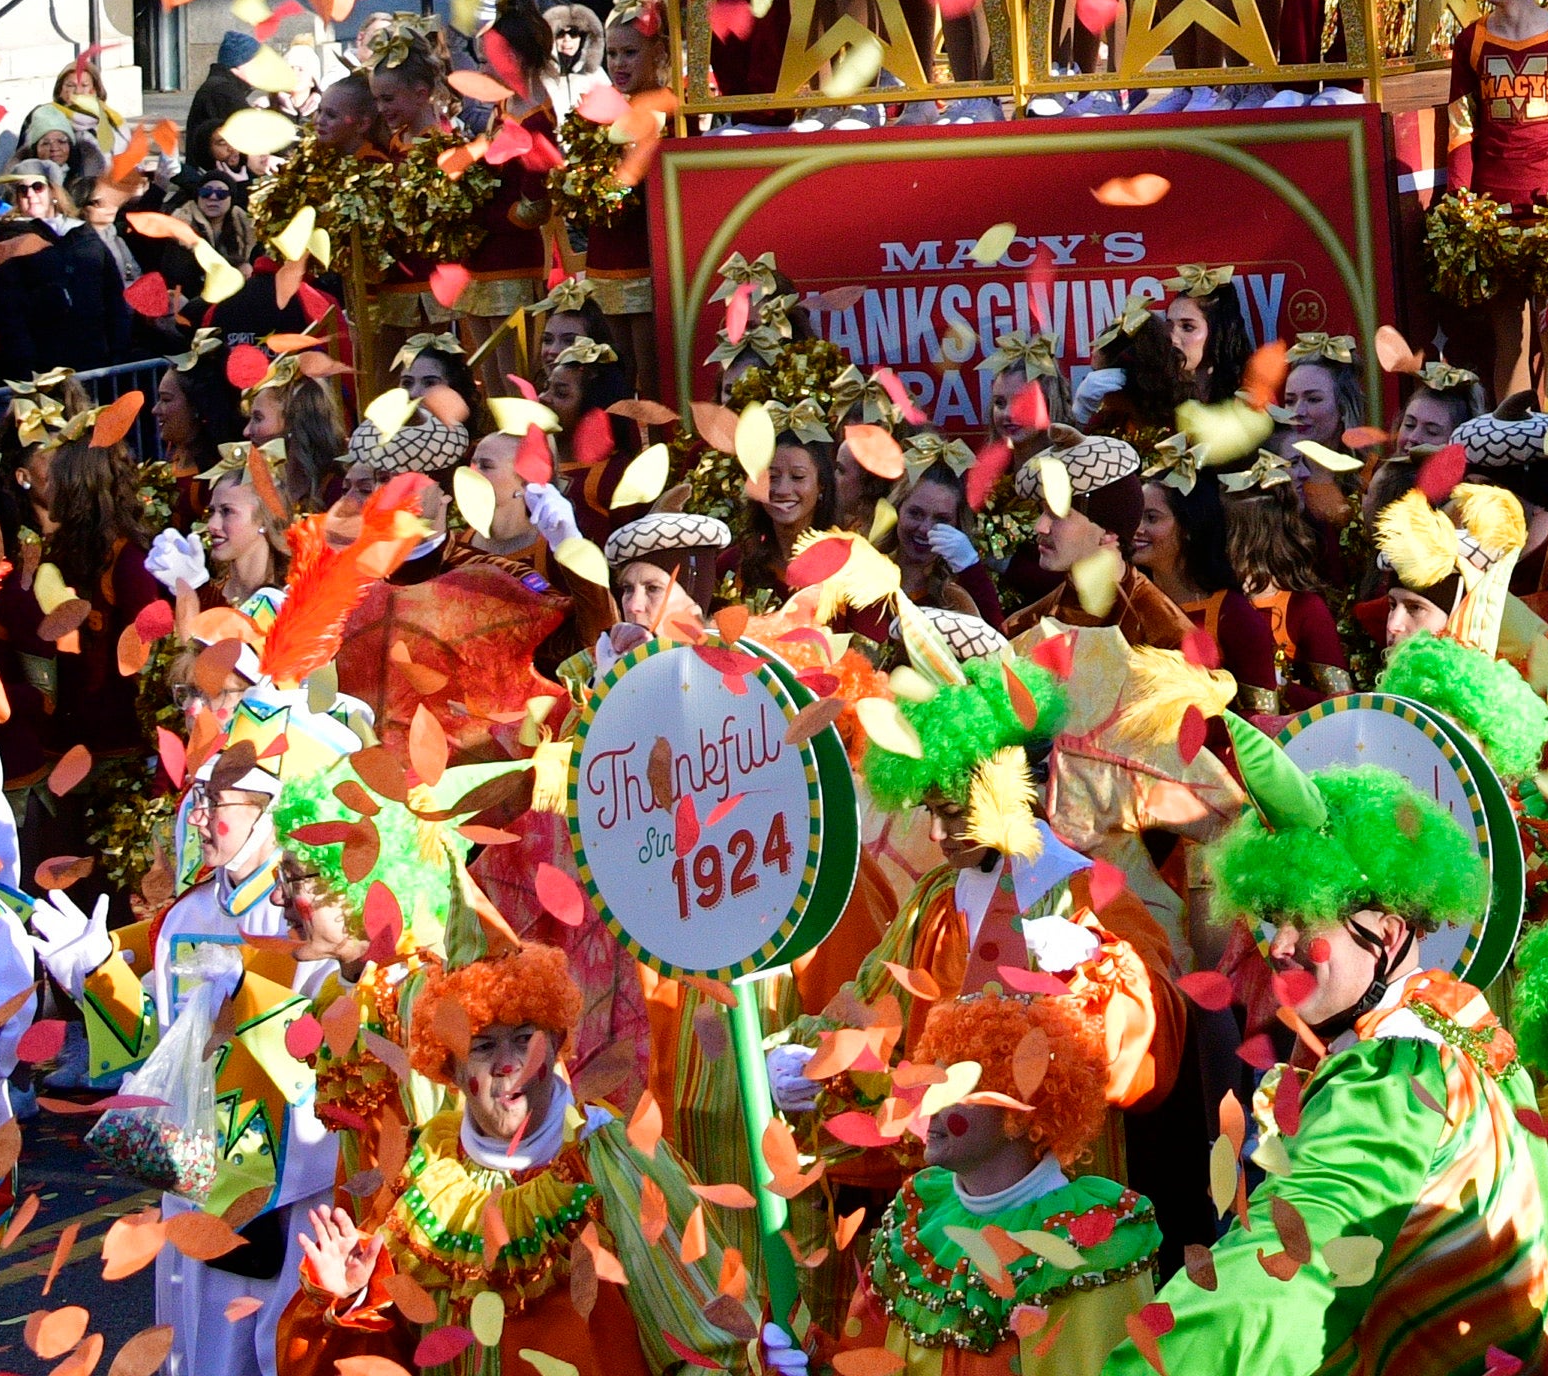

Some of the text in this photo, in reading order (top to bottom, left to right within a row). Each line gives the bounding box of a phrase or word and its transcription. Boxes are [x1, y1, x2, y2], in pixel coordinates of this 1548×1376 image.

[1295, 301, 1320, 322] 23
[586, 703, 781, 829] Thnkful
[638, 826, 677, 864] Sin
[671, 811, 793, 921] 1924
